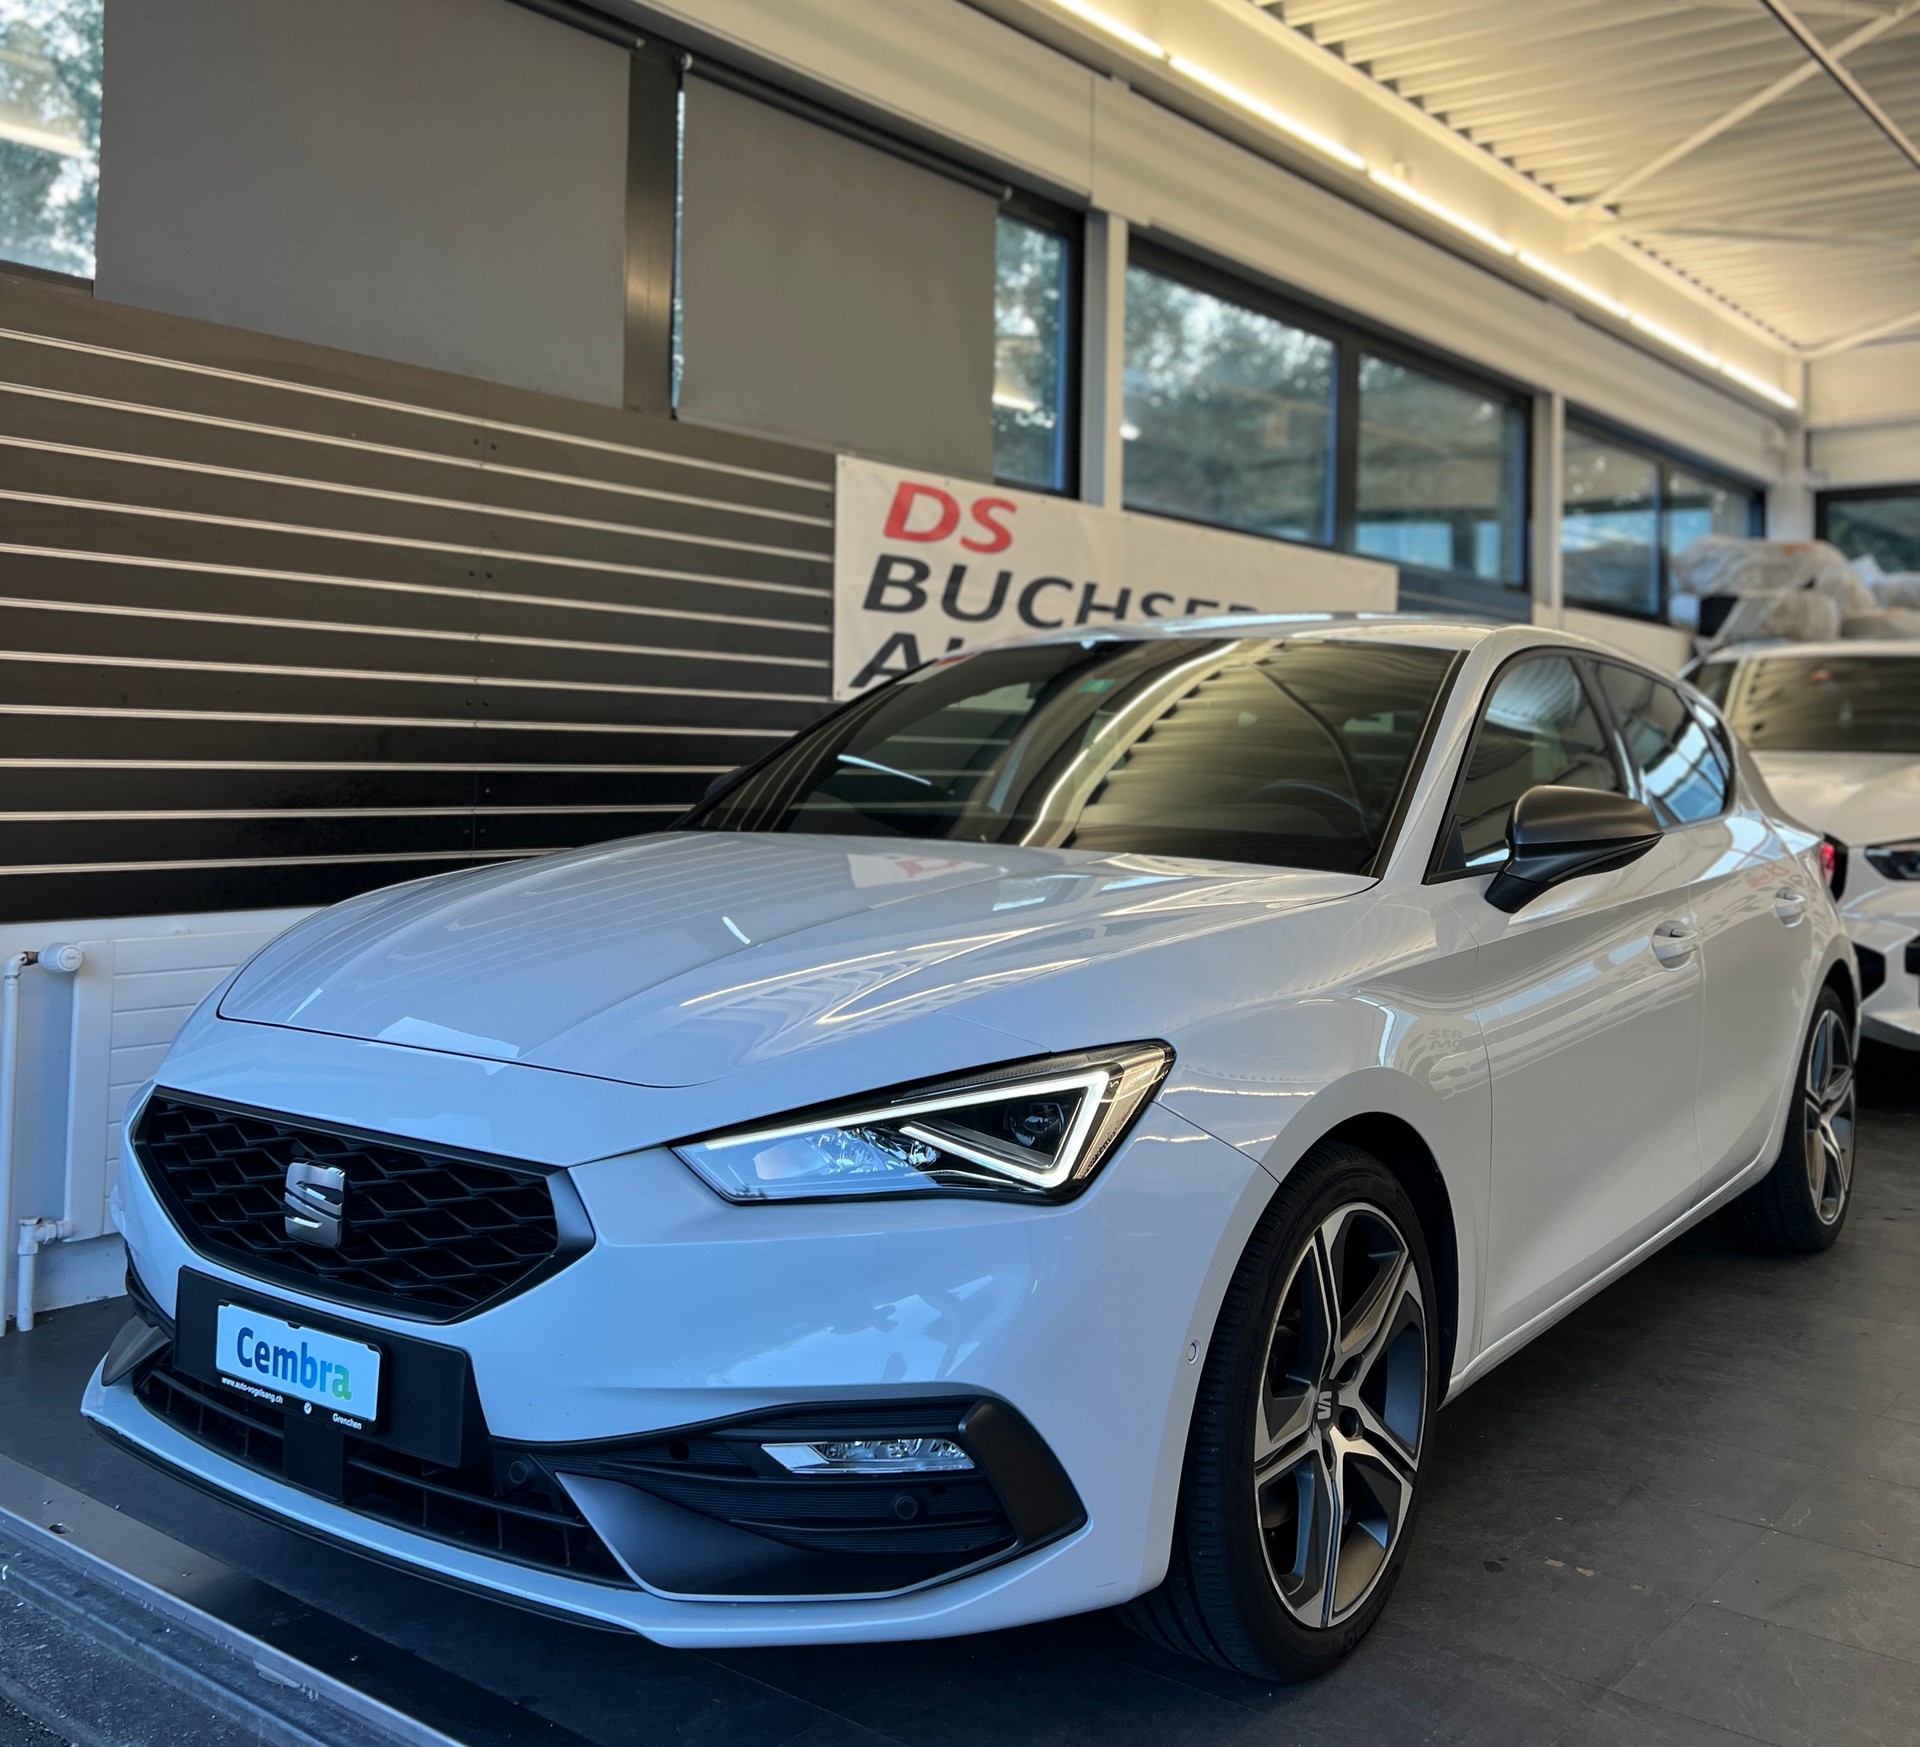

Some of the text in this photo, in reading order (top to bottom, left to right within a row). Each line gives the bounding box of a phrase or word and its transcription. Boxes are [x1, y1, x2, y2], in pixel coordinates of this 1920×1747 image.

[883, 480, 1016, 554] DS
[862, 554, 1259, 630] BUCHS
[221, 1377, 284, 1404] www.auto-vogelsang.ch
[237, 1327, 352, 1401] Cembra
[332, 1412, 362, 1431] Grenchen
